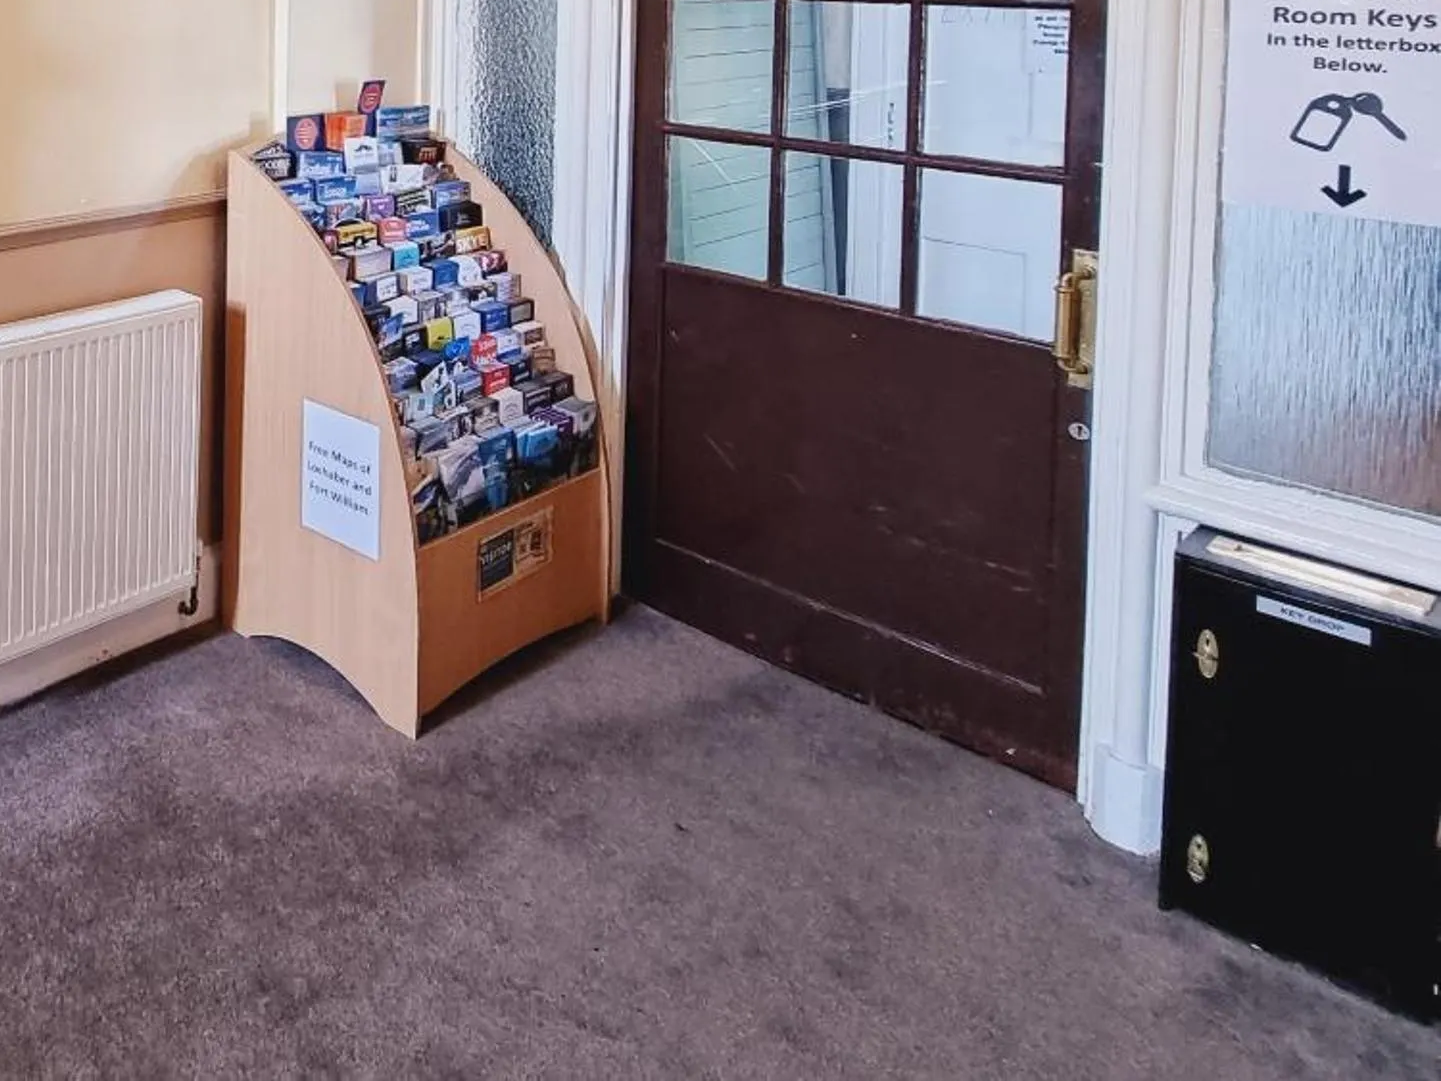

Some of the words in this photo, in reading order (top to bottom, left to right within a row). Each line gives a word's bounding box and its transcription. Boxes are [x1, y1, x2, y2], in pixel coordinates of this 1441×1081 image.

[1273, 6, 1357, 25] Room
[1367, 8, 1438, 32] Keys
[1267, 32, 1287, 46] In
[1293, 33, 1330, 49] the
[1336, 35, 1441, 53] letterbox
[1313, 56, 1388, 74] Below.
[309, 440, 329, 458] Free
[331, 450, 358, 470] Maps
[309, 480, 329, 498] Fort
[352, 480, 372, 497] and
